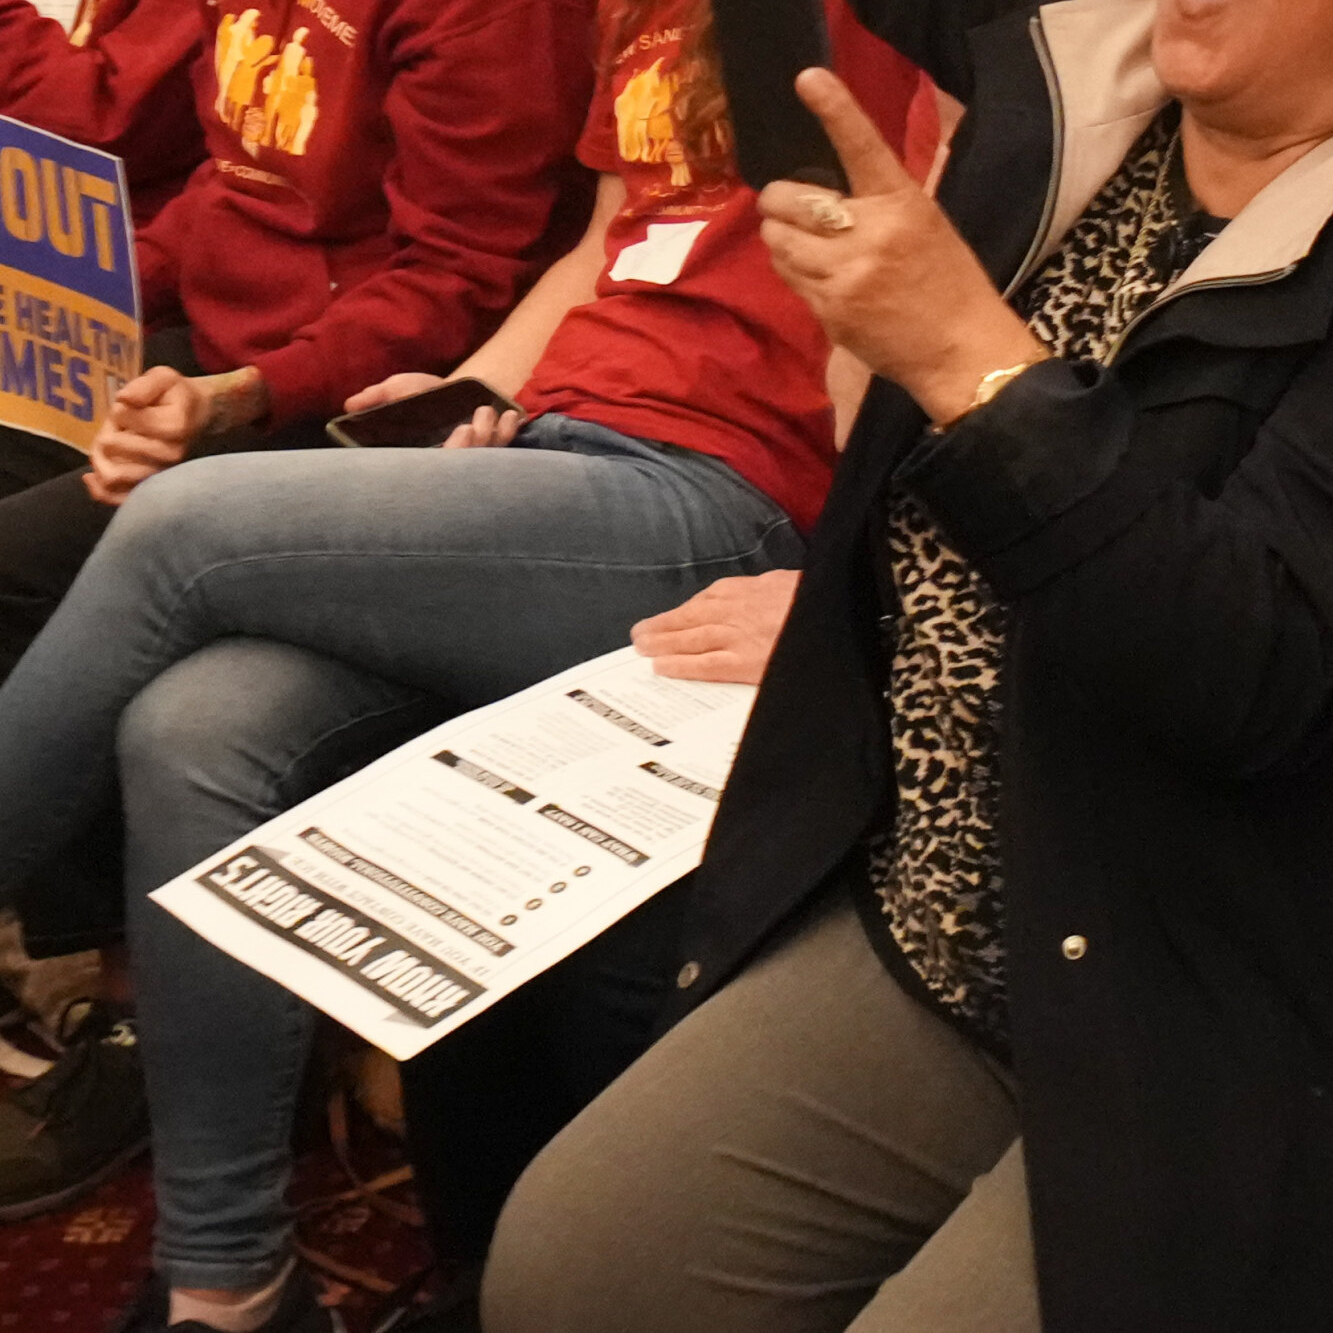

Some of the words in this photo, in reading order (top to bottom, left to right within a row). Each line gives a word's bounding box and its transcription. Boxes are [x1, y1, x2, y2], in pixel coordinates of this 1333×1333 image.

[0, 146, 117, 273] OUT
[0, 330, 94, 423] MES
[208, 855, 323, 928] RIGHTS
[293, 908, 387, 966] YOUR
[359, 950, 470, 1017] KNOW
